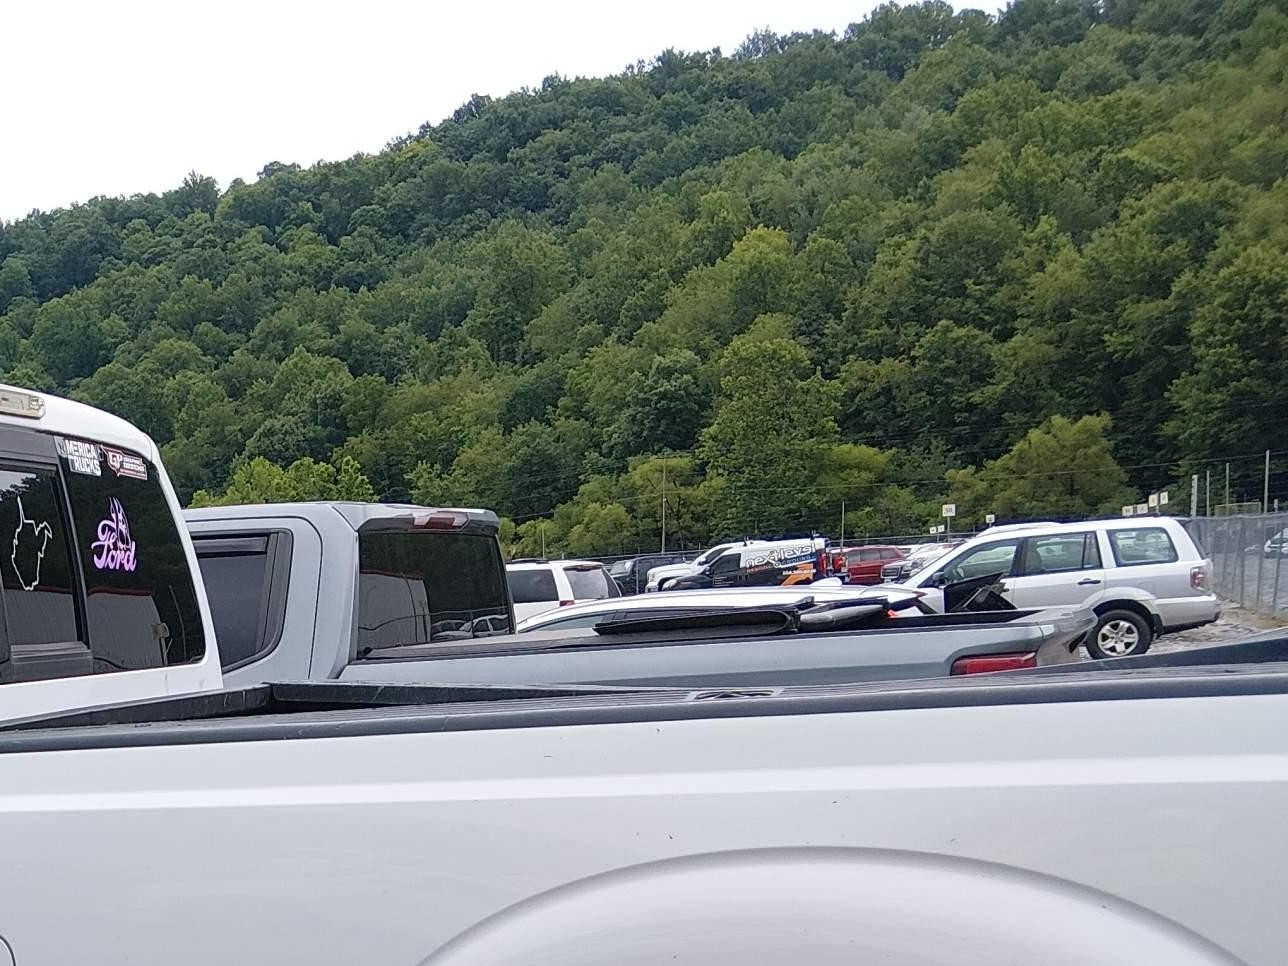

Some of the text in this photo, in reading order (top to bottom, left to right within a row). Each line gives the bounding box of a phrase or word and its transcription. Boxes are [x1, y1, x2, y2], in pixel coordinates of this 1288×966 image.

[67, 454, 101, 475] TRUCKS
[91, 519, 137, 572] Ford
[746, 542, 817, 568] next level
